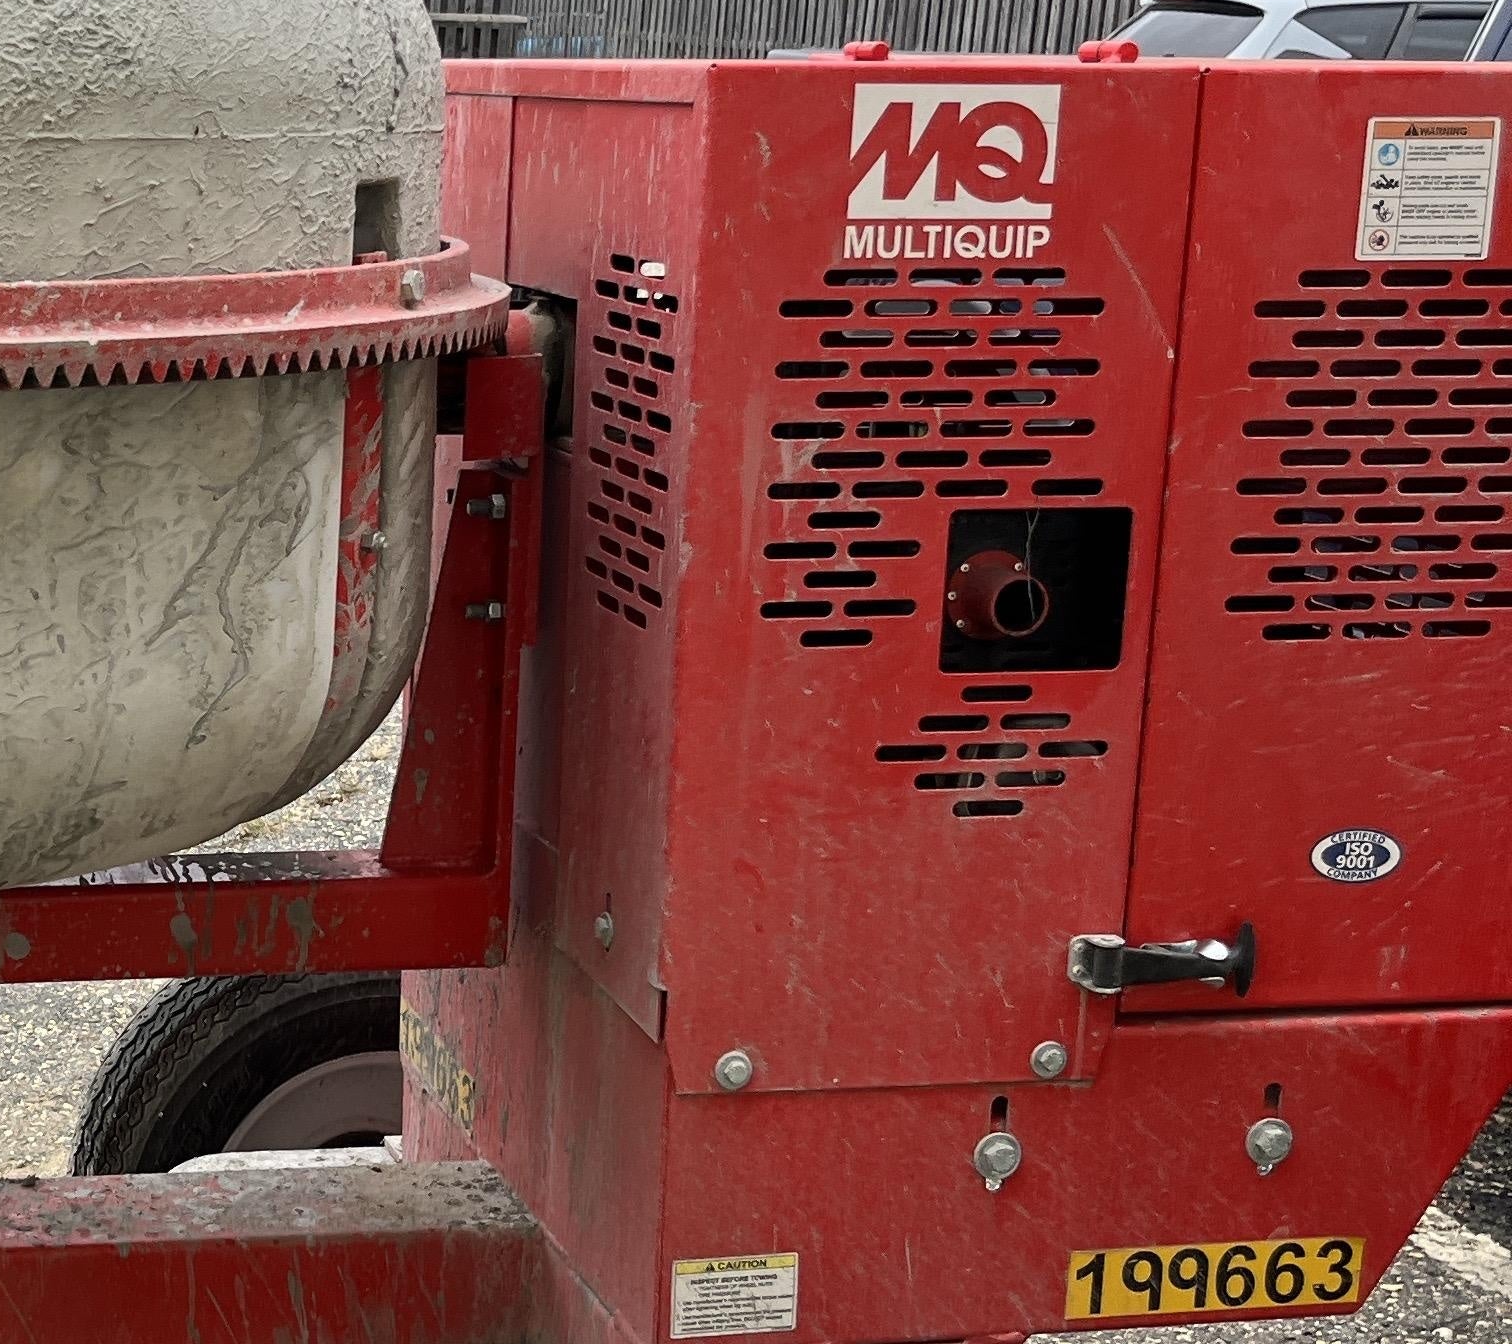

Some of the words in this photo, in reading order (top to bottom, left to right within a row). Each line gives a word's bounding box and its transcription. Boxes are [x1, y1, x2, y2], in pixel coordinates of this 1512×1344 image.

[1419, 126, 1468, 136] WARNING
[848, 100, 1054, 205] MQ
[843, 224, 1051, 259] MULTIQUIP
[1330, 831, 1386, 845] CERTIFIED
[1345, 842, 1373, 856] ISO
[1335, 855, 1375, 869] 9001
[1326, 867, 1379, 881] COMPANY
[717, 1259, 767, 1270] CAUTION
[1075, 1240, 1354, 1315] 199663
